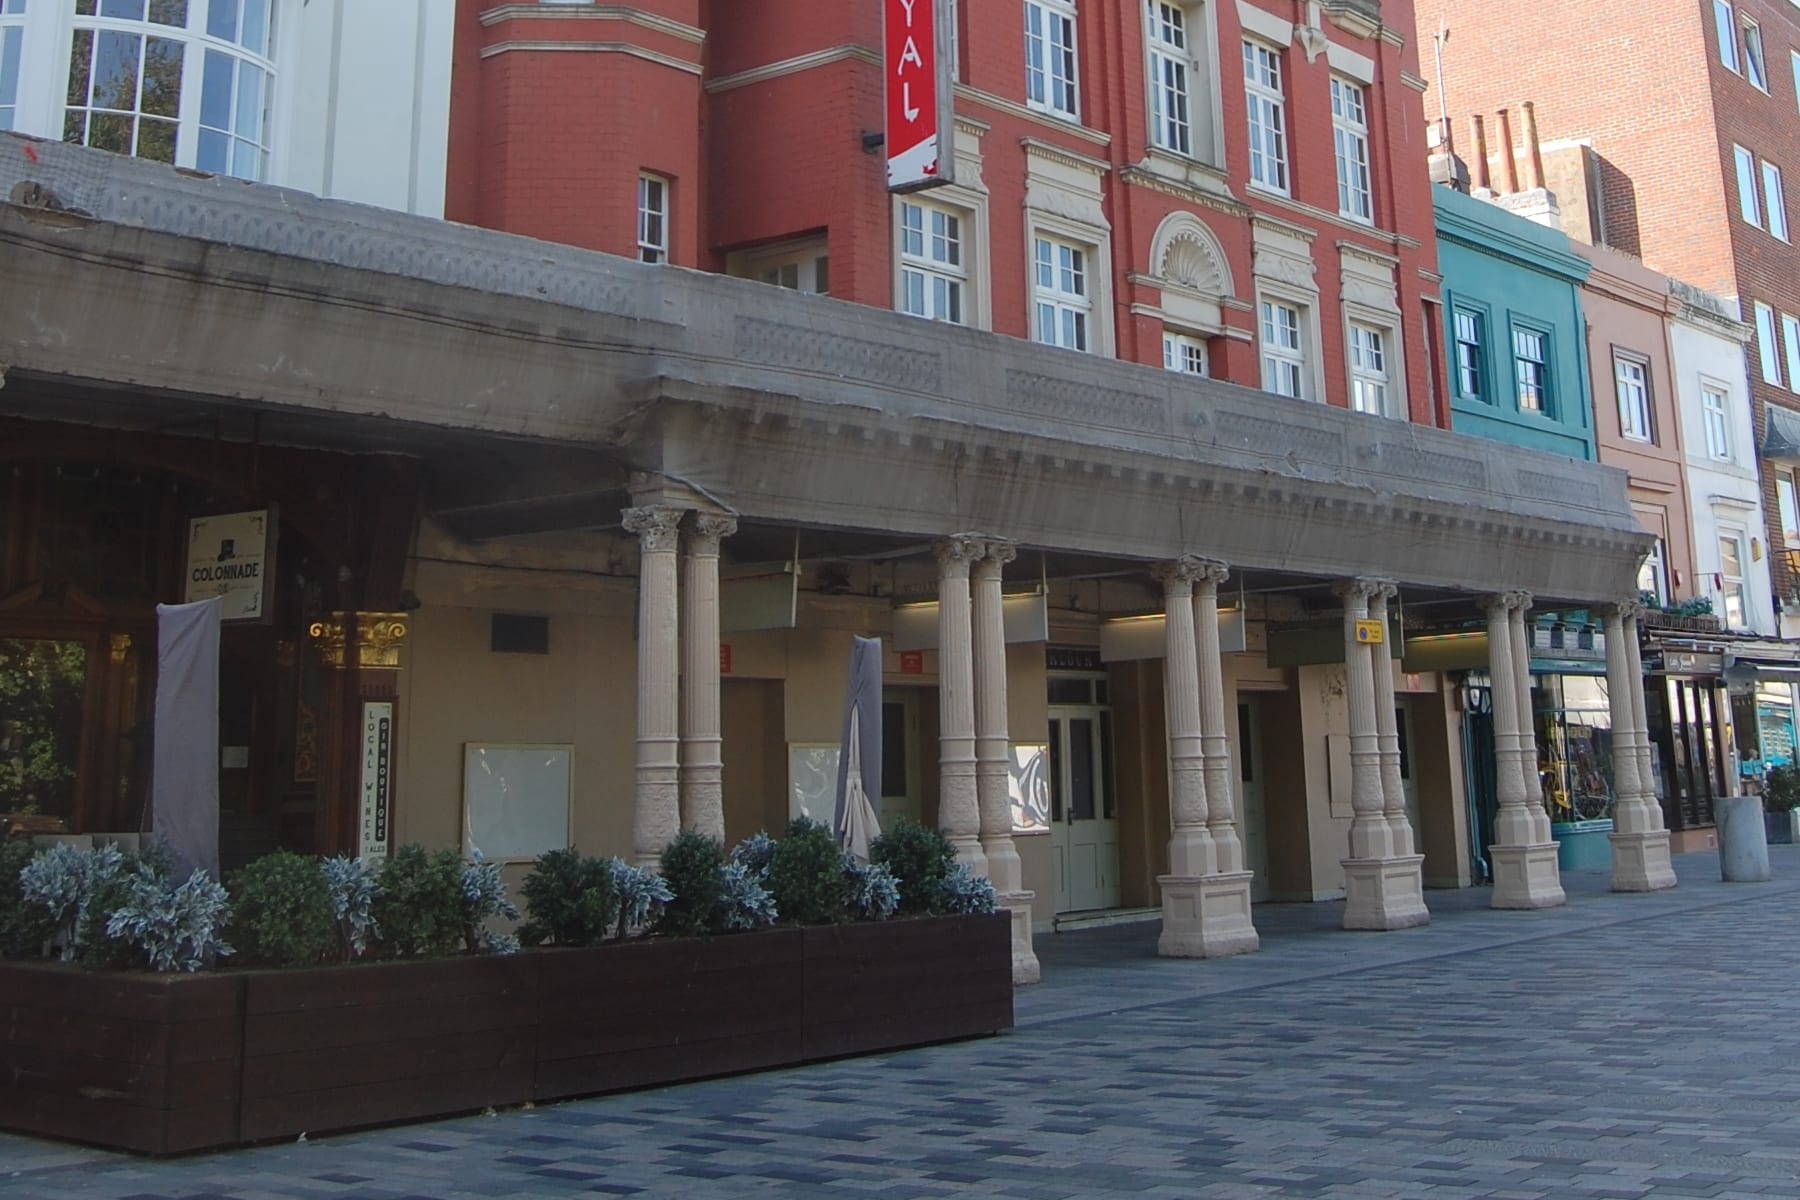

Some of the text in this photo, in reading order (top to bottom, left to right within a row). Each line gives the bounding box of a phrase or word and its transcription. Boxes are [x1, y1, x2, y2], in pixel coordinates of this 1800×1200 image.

[192, 562, 259, 582] COLONNADE
[365, 710, 375, 841] LOCAL WINES
